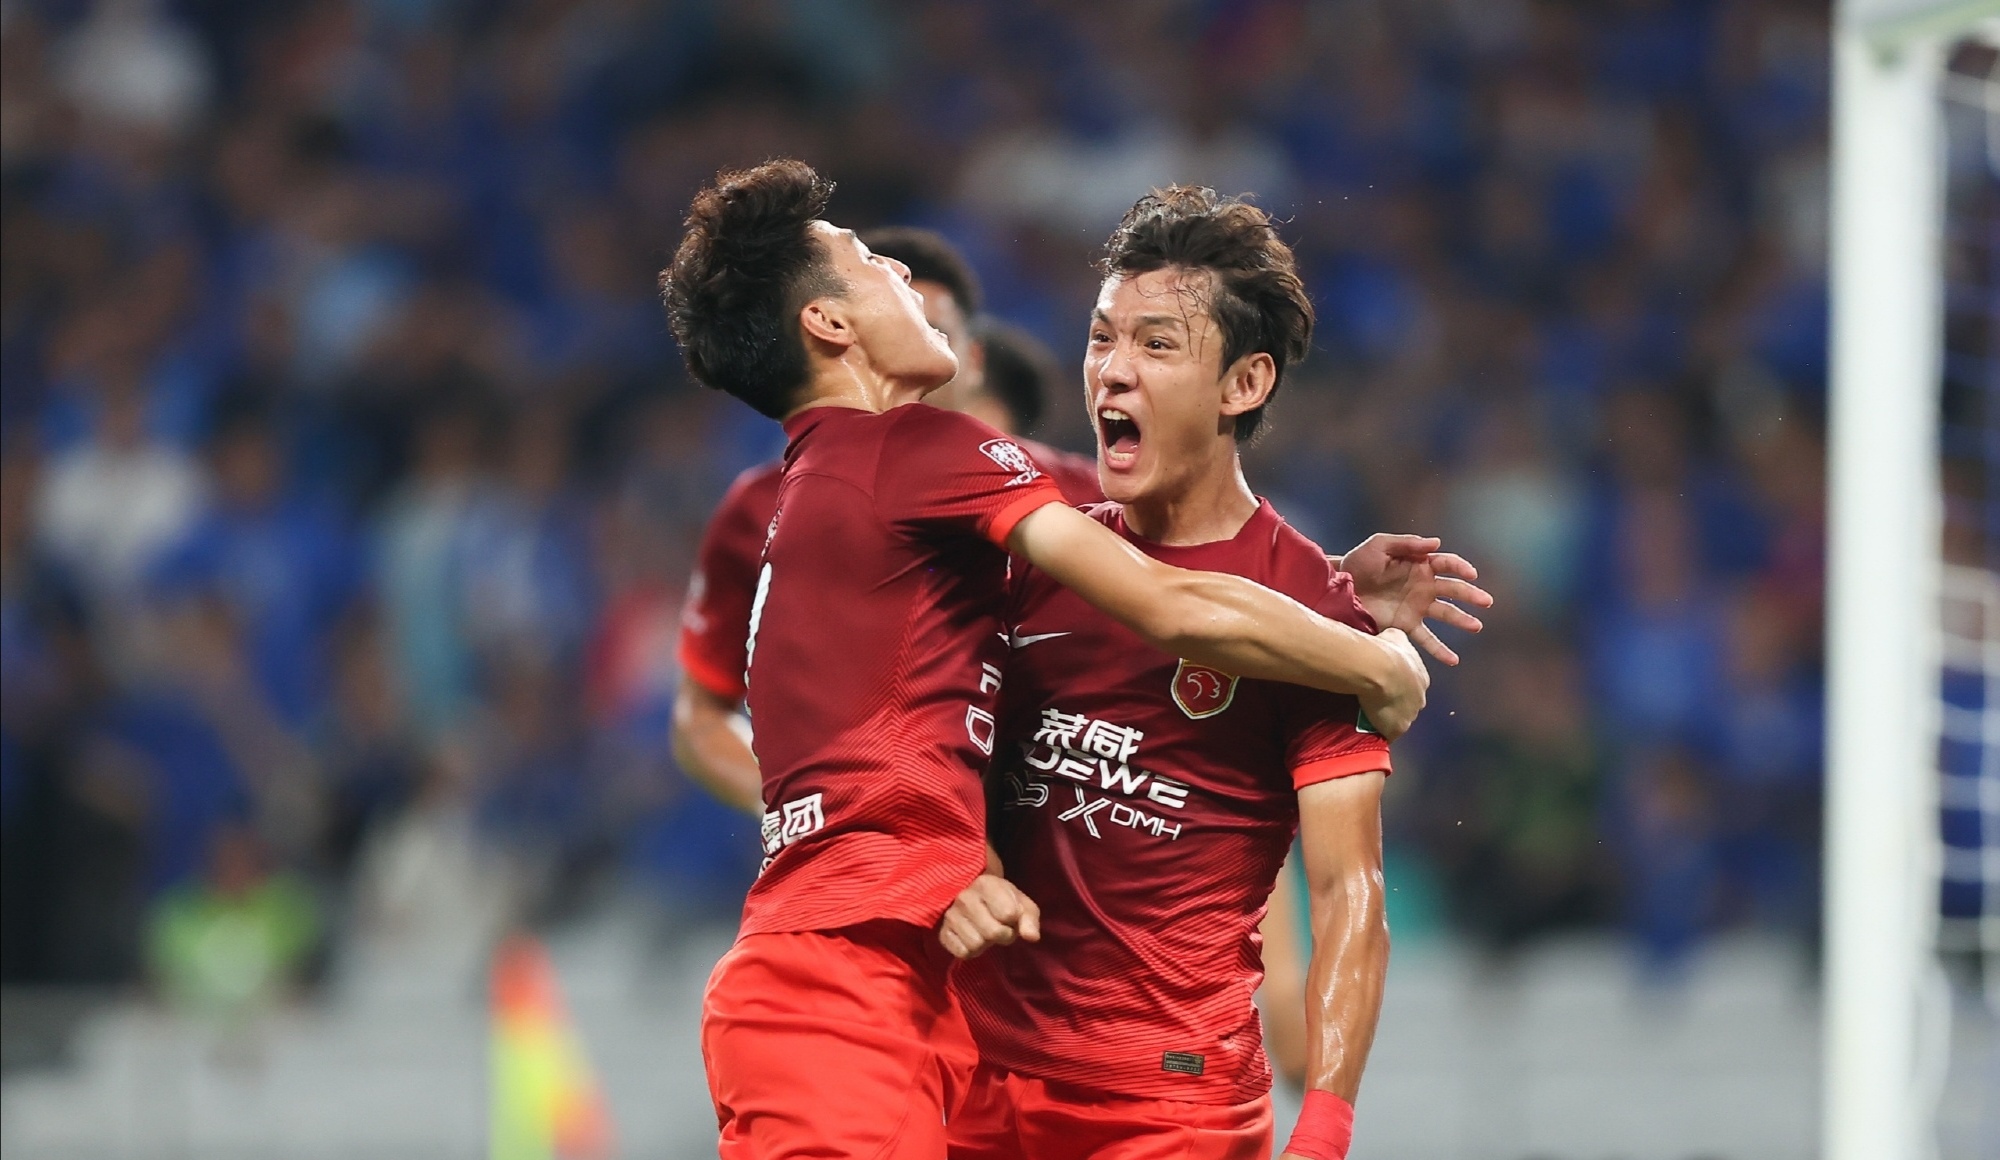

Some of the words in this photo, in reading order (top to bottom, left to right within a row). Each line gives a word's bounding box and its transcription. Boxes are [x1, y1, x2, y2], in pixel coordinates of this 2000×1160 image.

[1032, 708, 1144, 764] 荣威
[1057, 782, 1113, 839] X
[1110, 803, 1182, 840] DMH
